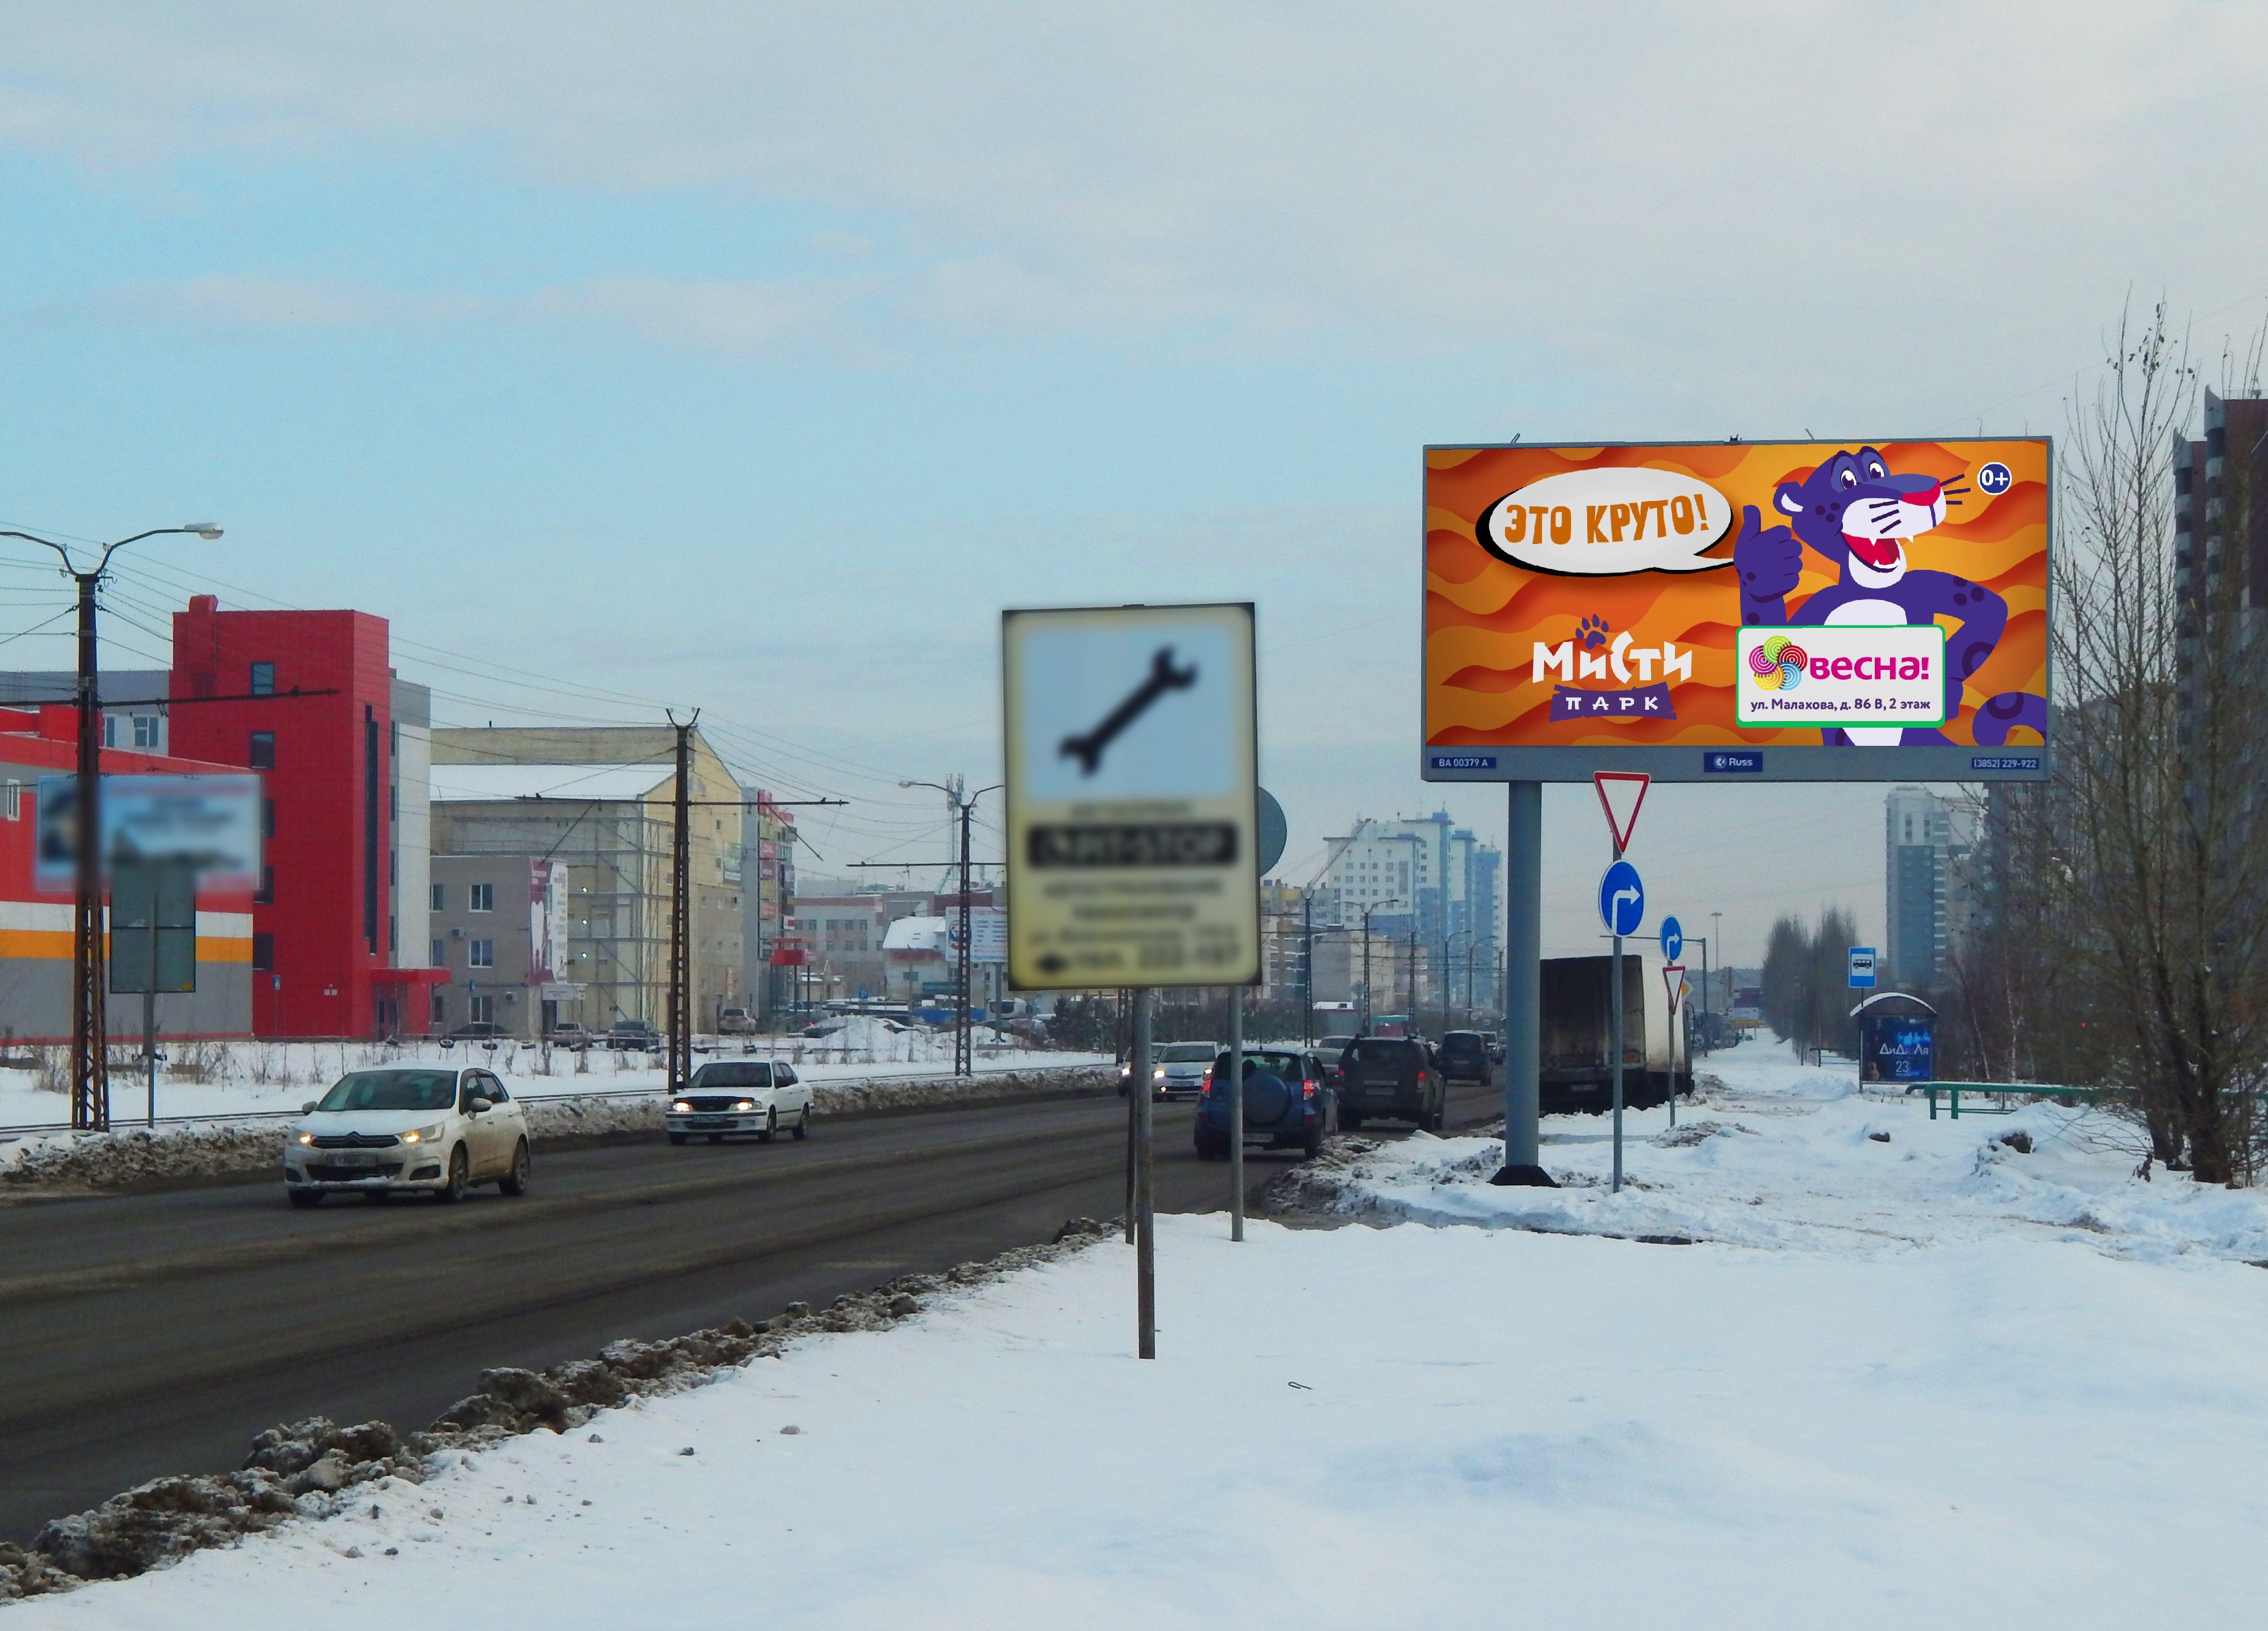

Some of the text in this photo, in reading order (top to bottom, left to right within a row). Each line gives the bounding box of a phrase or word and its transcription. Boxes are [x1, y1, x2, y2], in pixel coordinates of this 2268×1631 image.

[1981, 469, 2009, 486] 0+
[1504, 493, 1709, 545] ЭТО КРУТО!
[1809, 656, 1929, 680] весна!
[1565, 696, 1659, 711] ПАРК
[1750, 698, 1931, 712] ул. Малахова, д. 86 В, 2 этаж
[1453, 758, 1480, 767] 00379
[1729, 758, 1753, 766] Russ
[1974, 759, 2037, 768] (3852) 229-922
[1896, 1060, 1909, 1073] 23
